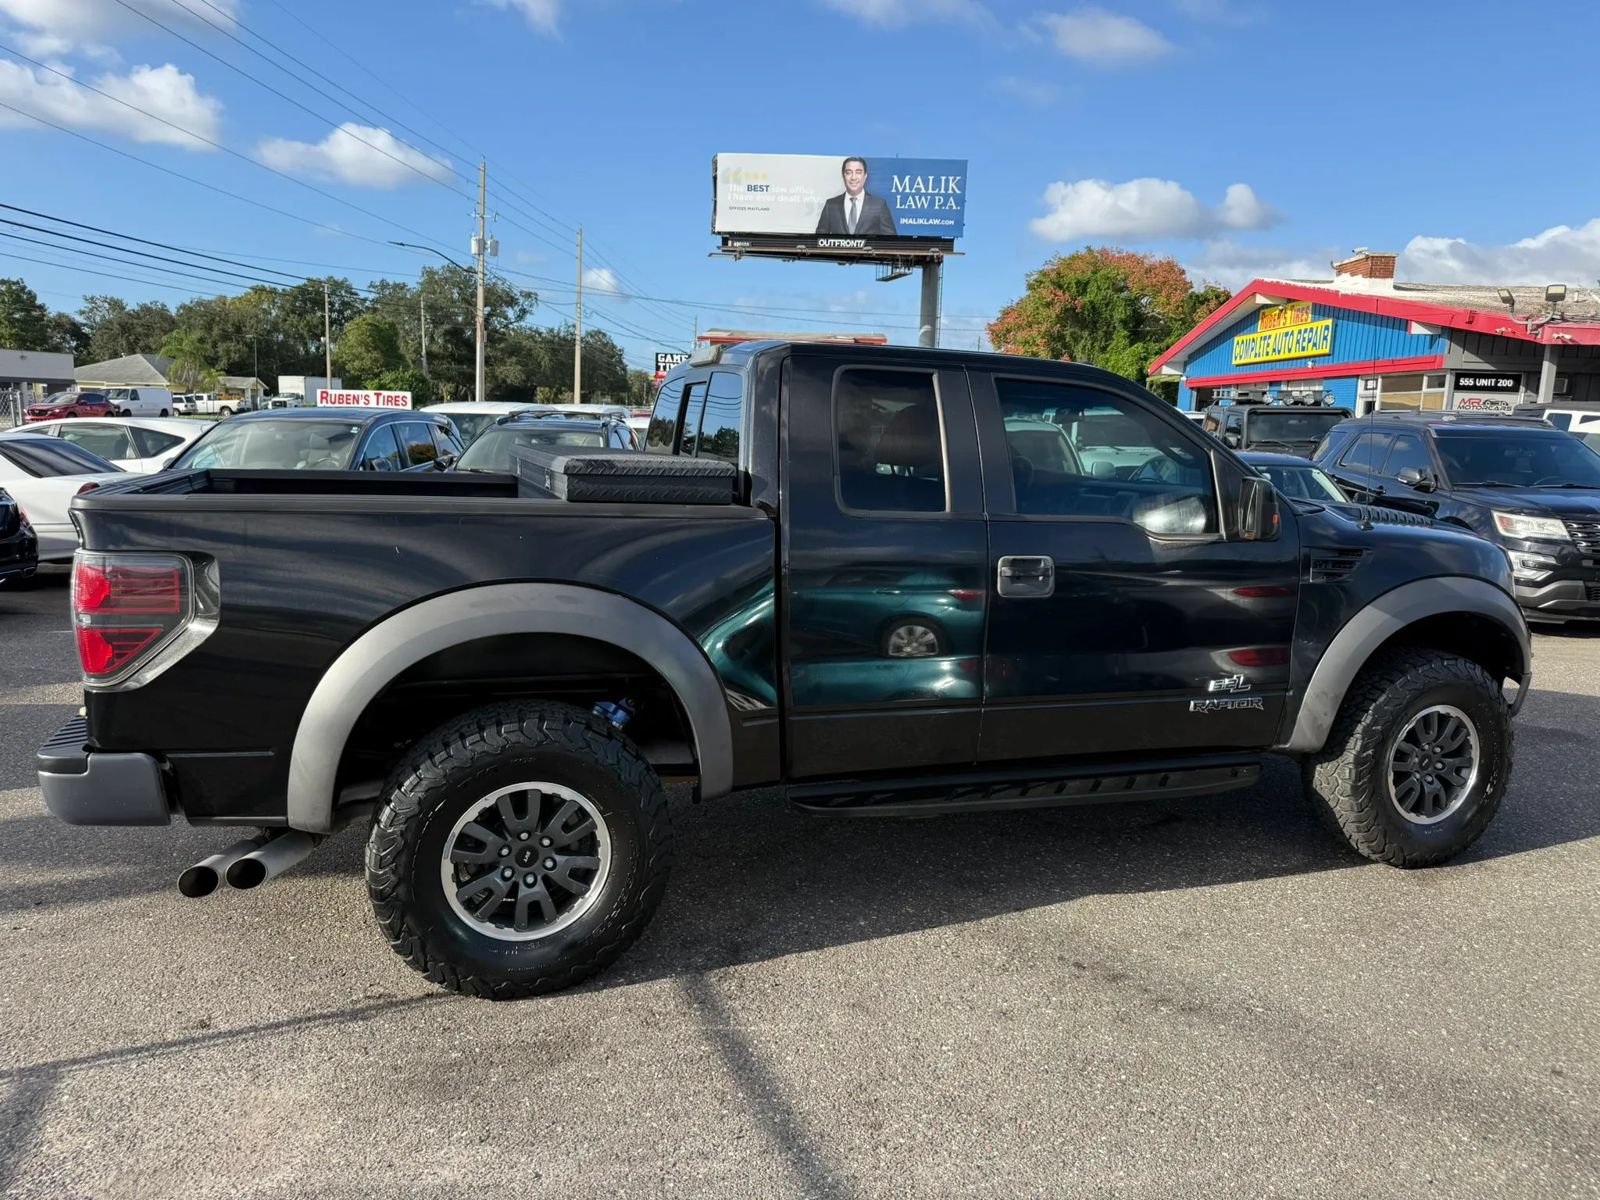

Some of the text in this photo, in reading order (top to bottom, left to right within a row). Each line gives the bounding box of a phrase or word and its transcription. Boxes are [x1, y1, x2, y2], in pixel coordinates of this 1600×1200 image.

[747, 184, 770, 192] BEST
[890, 175, 961, 193] MALIK
[896, 195, 960, 210] LAW P.A.
[1272, 330, 1294, 355] AUTO
[1296, 325, 1330, 352] REPAIR
[1459, 378, 1513, 387] 555 UNIT 200
[320, 391, 408, 406] RUBEN'S TIRES
[1189, 697, 1264, 713] RAPTOR
